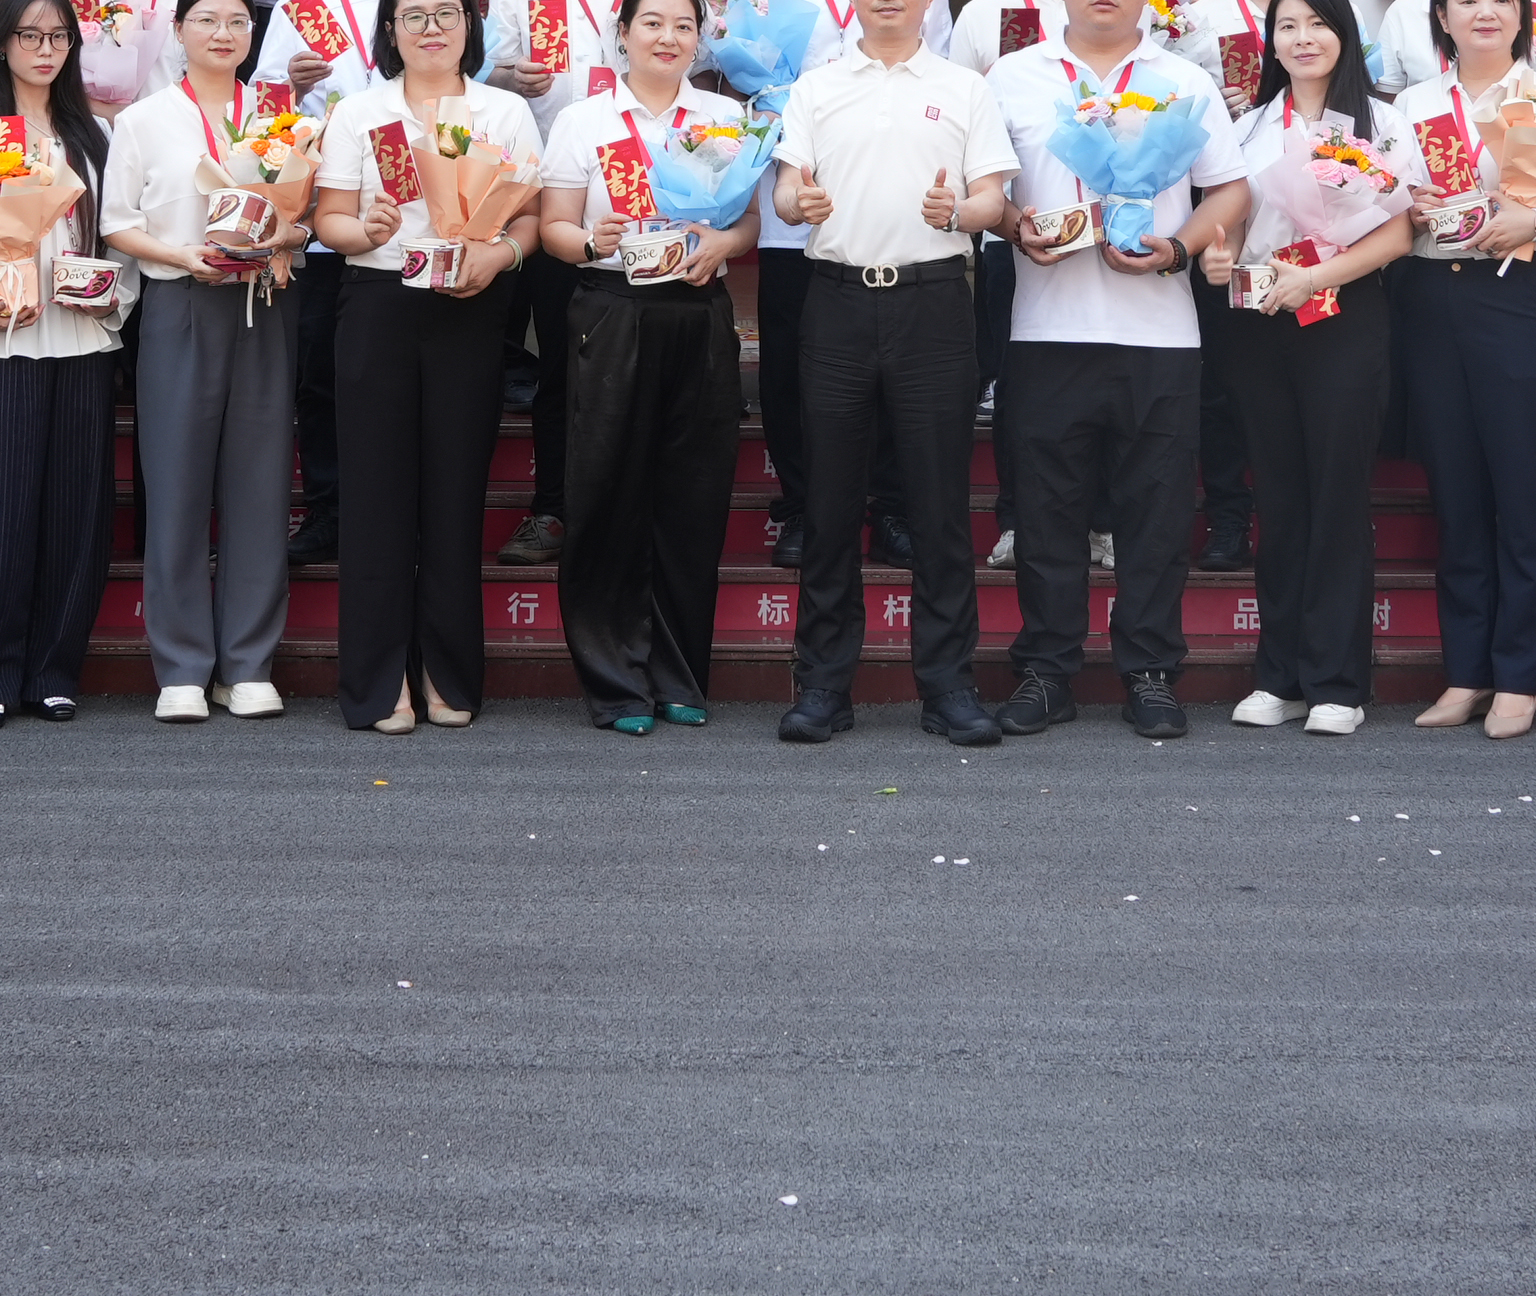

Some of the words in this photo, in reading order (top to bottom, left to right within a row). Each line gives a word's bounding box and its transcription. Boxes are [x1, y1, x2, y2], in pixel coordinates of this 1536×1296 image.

[282, 1, 320, 45] 大吉
[314, 5, 355, 55] 大利
[528, 0, 550, 50] 大吉
[543, 24, 570, 74] 大利
[1220, 36, 1243, 85] 大吉
[372, 129, 397, 181] 大吉
[395, 144, 423, 200] 大利
[599, 146, 627, 198] 大吉
[1416, 121, 1446, 173] 大吉
[1444, 135, 1477, 192] 大利
[624, 160, 658, 219] 大利
[1429, 216, 1458, 234] Dove
[55, 267, 90, 284] Dove
[624, 248, 658, 268] Dove
[506, 591, 540, 625] 行
[757, 597, 791, 630] 标
